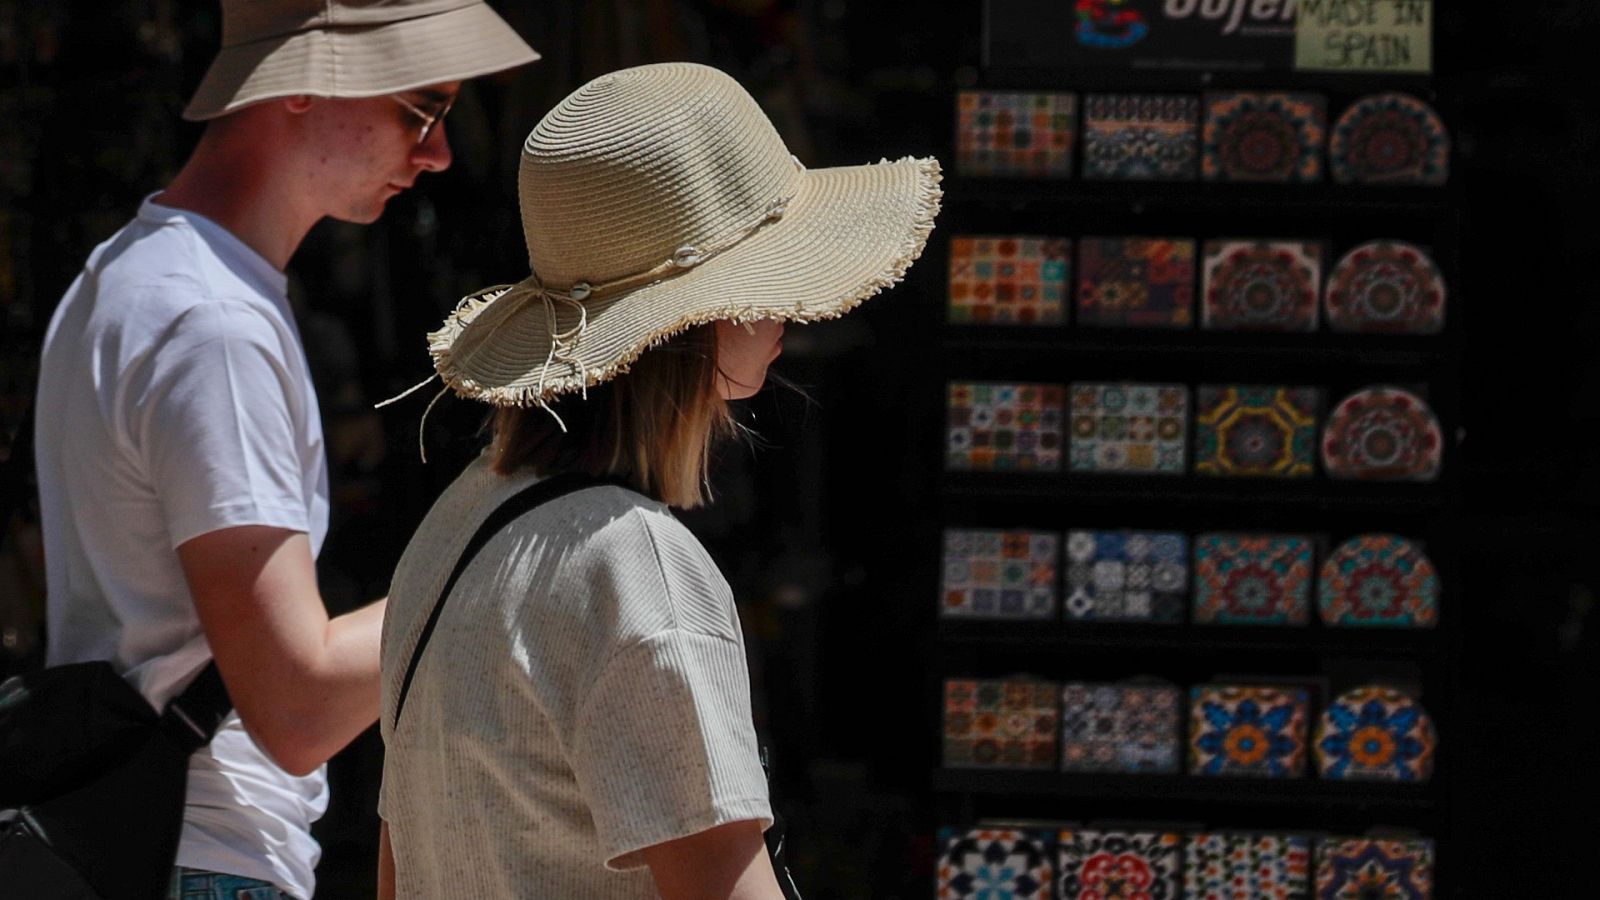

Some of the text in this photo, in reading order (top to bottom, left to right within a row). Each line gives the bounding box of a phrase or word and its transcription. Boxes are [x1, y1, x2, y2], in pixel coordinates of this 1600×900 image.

[1300, 0, 1423, 27] MADE IN
[1322, 30, 1411, 67] SPAIN
